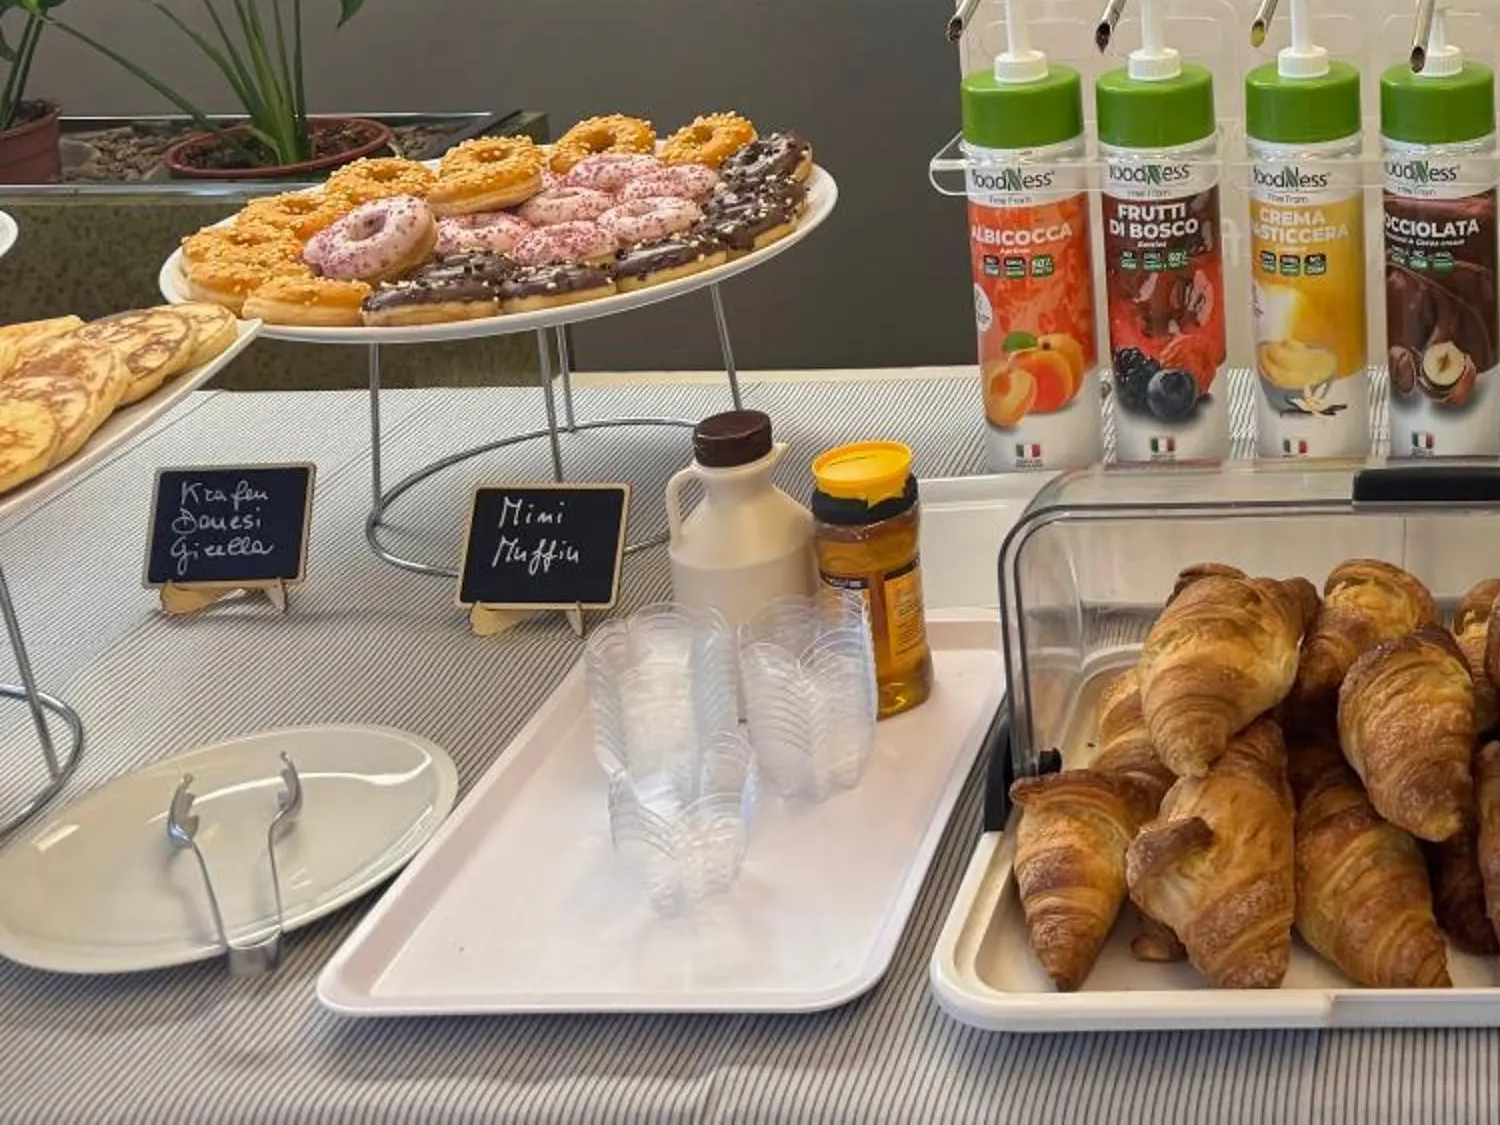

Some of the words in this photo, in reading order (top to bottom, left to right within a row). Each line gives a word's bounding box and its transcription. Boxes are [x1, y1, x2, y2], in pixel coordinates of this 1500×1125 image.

[1117, 202, 1187, 222] FRUTTI
[1259, 207, 1327, 227] CREMA
[1109, 218, 1126, 237] DI
[1129, 218, 1200, 240] BOSCO
[1384, 213, 1480, 238] OCCIOLATA
[498, 495, 566, 530] Mini
[491, 535, 580, 576] Muffin
